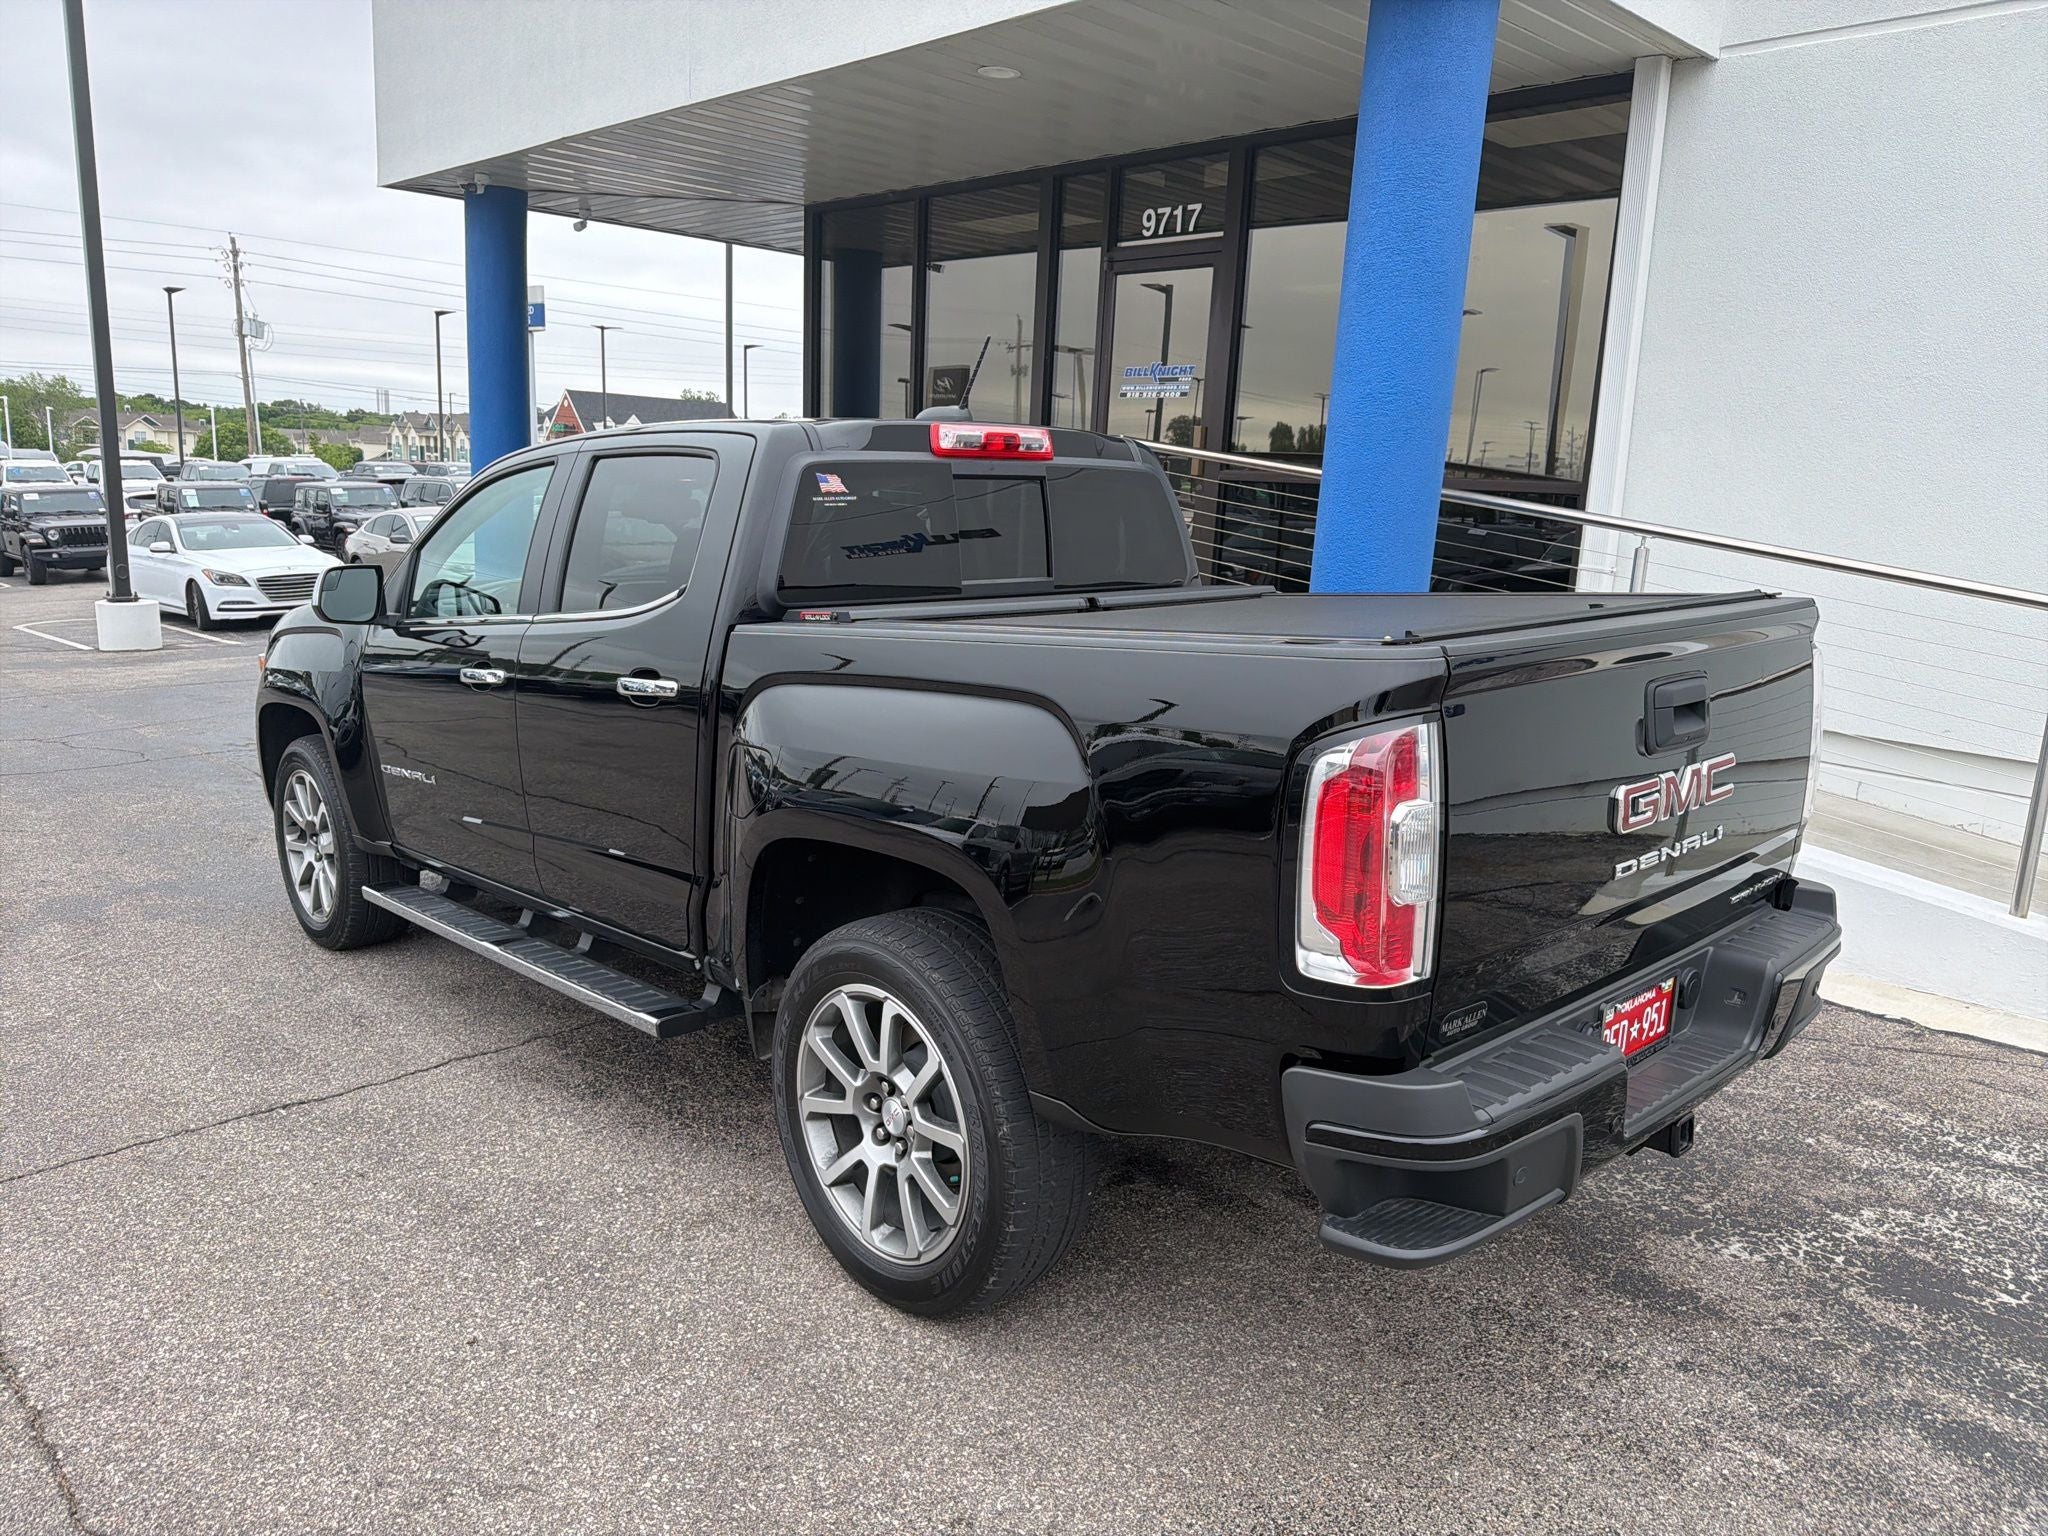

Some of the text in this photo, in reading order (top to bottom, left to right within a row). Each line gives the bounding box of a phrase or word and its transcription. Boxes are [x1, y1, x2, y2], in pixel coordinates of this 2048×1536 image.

[1141, 203, 1202, 237] 9717
[381, 764, 436, 785] DENALI
[1607, 752, 1737, 835] GMC
[1613, 824, 1724, 880] DENALI
[1621, 988, 1657, 1014] OKLAHOMA
[1440, 1009, 1487, 1034] MARK ALLEN
[1641, 998, 1668, 1041] 951
